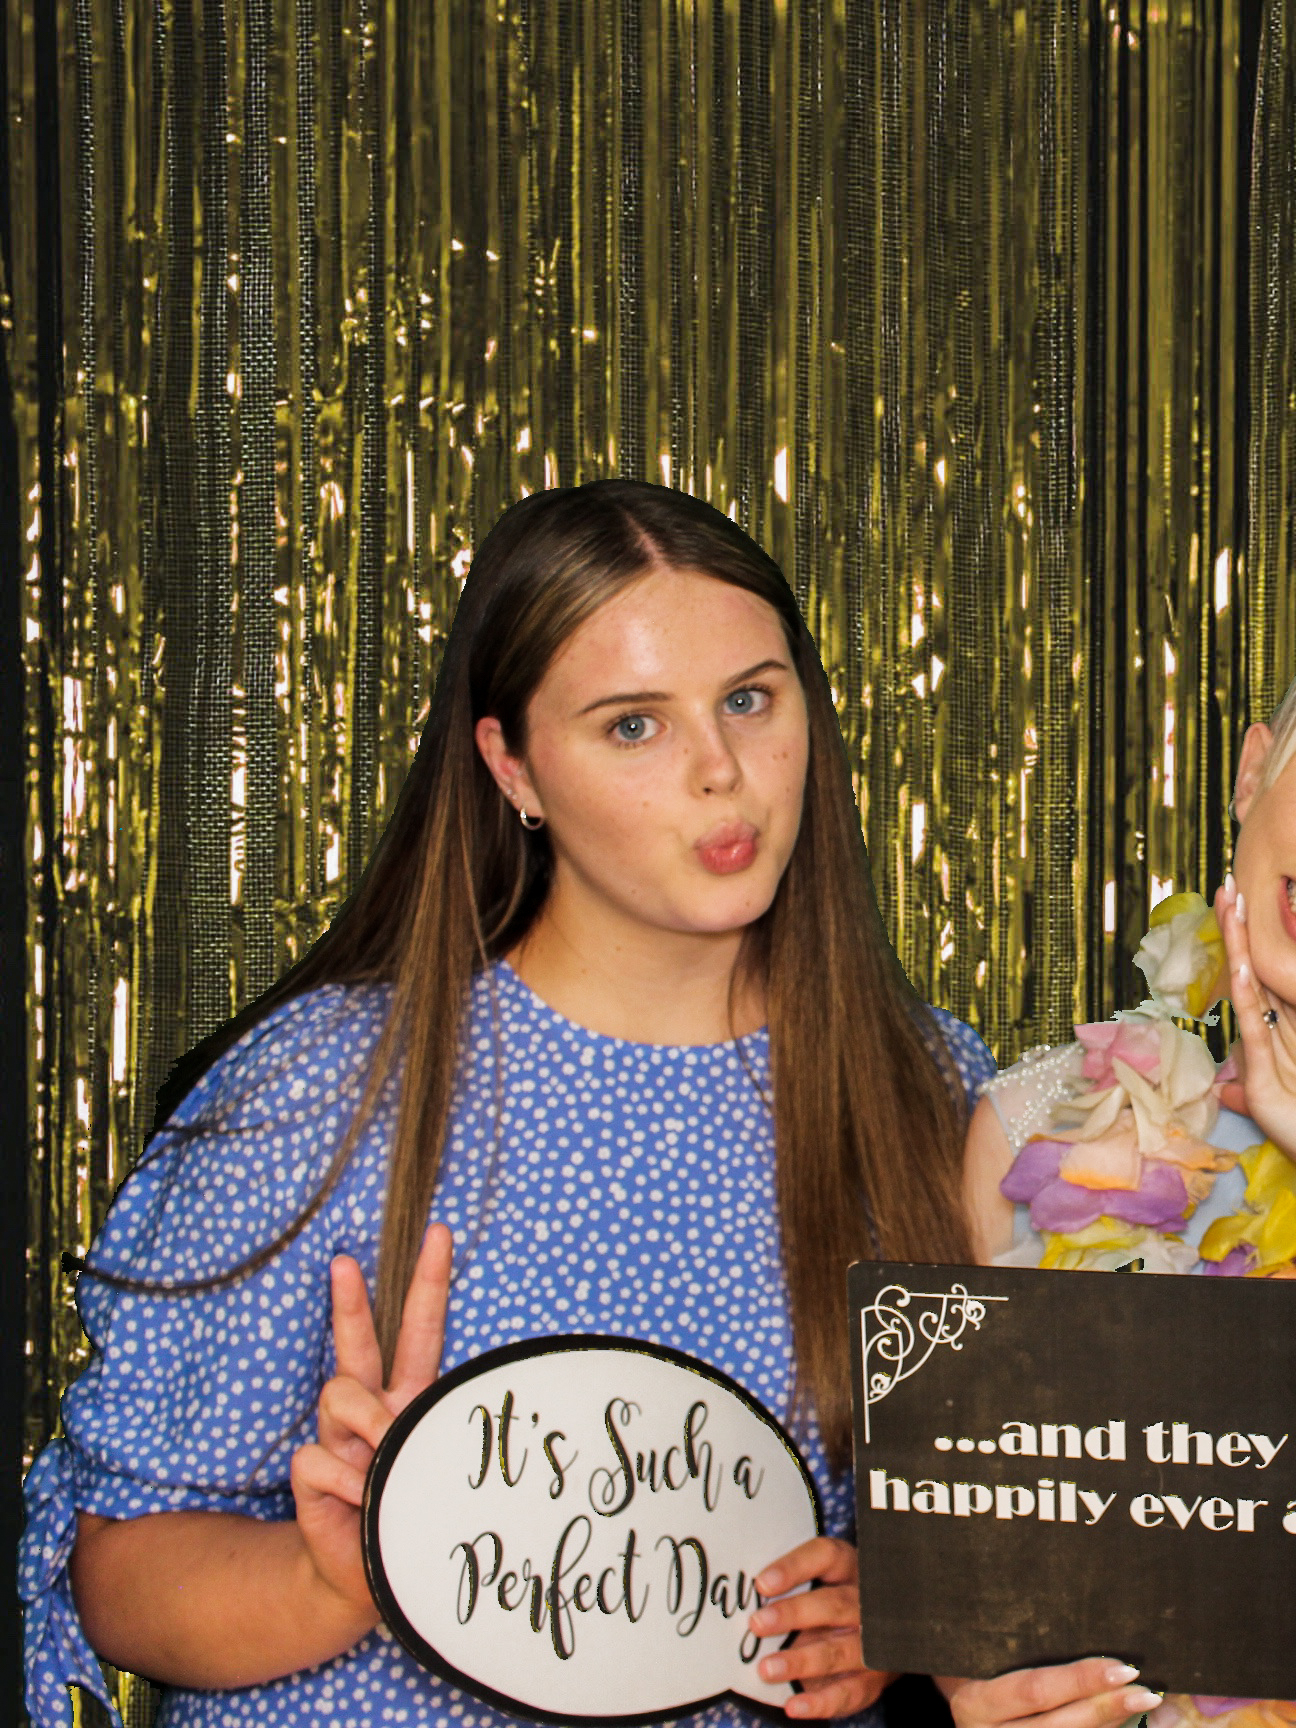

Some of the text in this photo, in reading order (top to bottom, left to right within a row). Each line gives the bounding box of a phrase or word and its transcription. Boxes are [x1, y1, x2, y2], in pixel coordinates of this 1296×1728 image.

[467, 1390, 765, 1517] It's Such a
[934, 1418, 1126, 1462] ...and
[1142, 1421, 1289, 1468] they
[868, 1468, 1117, 1526] happily
[1129, 1491, 1270, 1533] ever
[449, 1514, 768, 1664] Perfect Day
